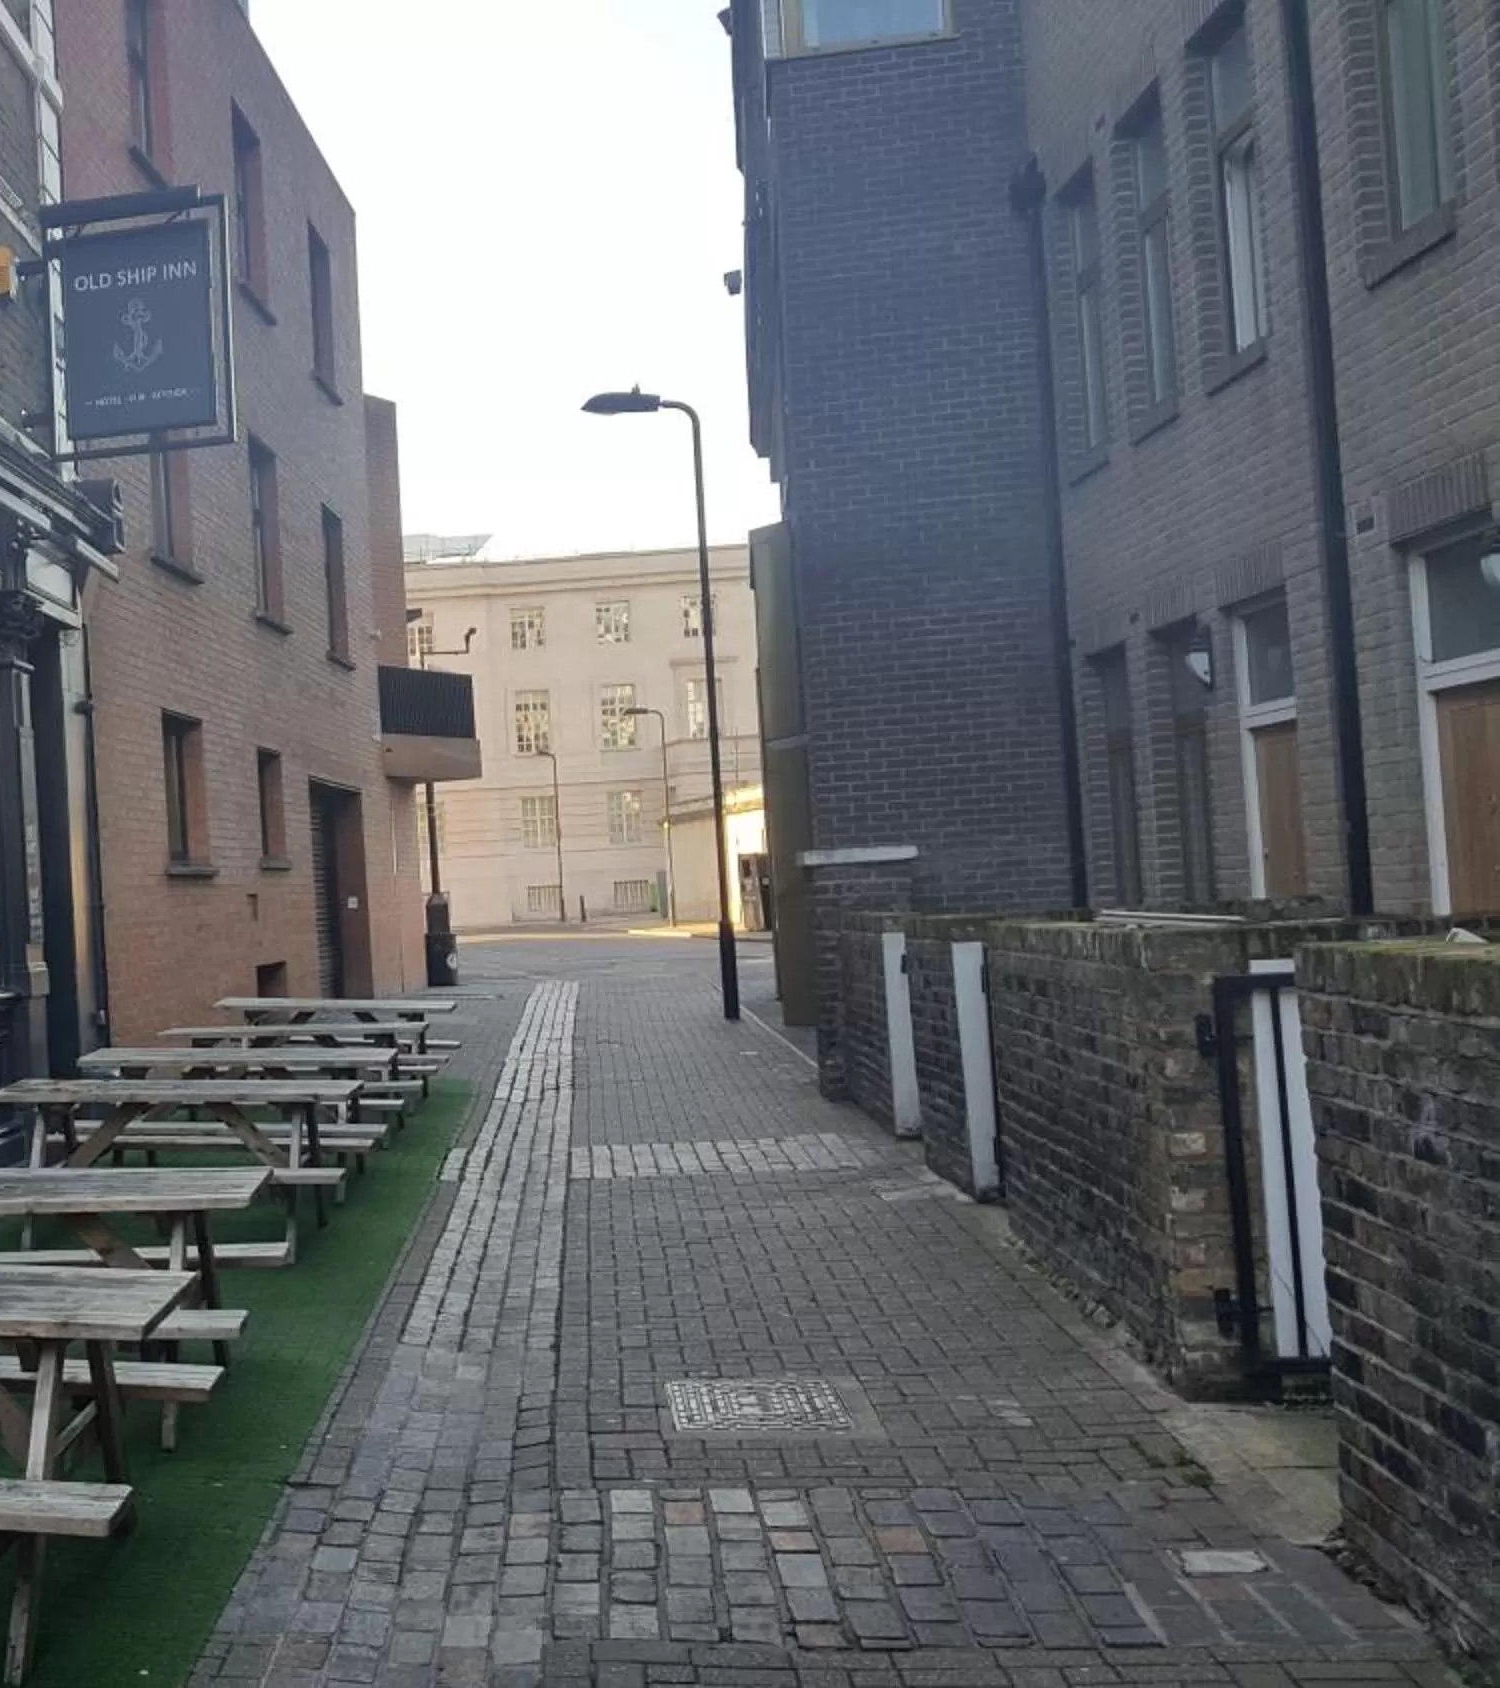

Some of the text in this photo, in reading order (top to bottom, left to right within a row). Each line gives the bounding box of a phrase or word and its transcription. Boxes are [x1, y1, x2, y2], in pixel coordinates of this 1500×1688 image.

[74, 260, 197, 291] OLD SHIP INN
